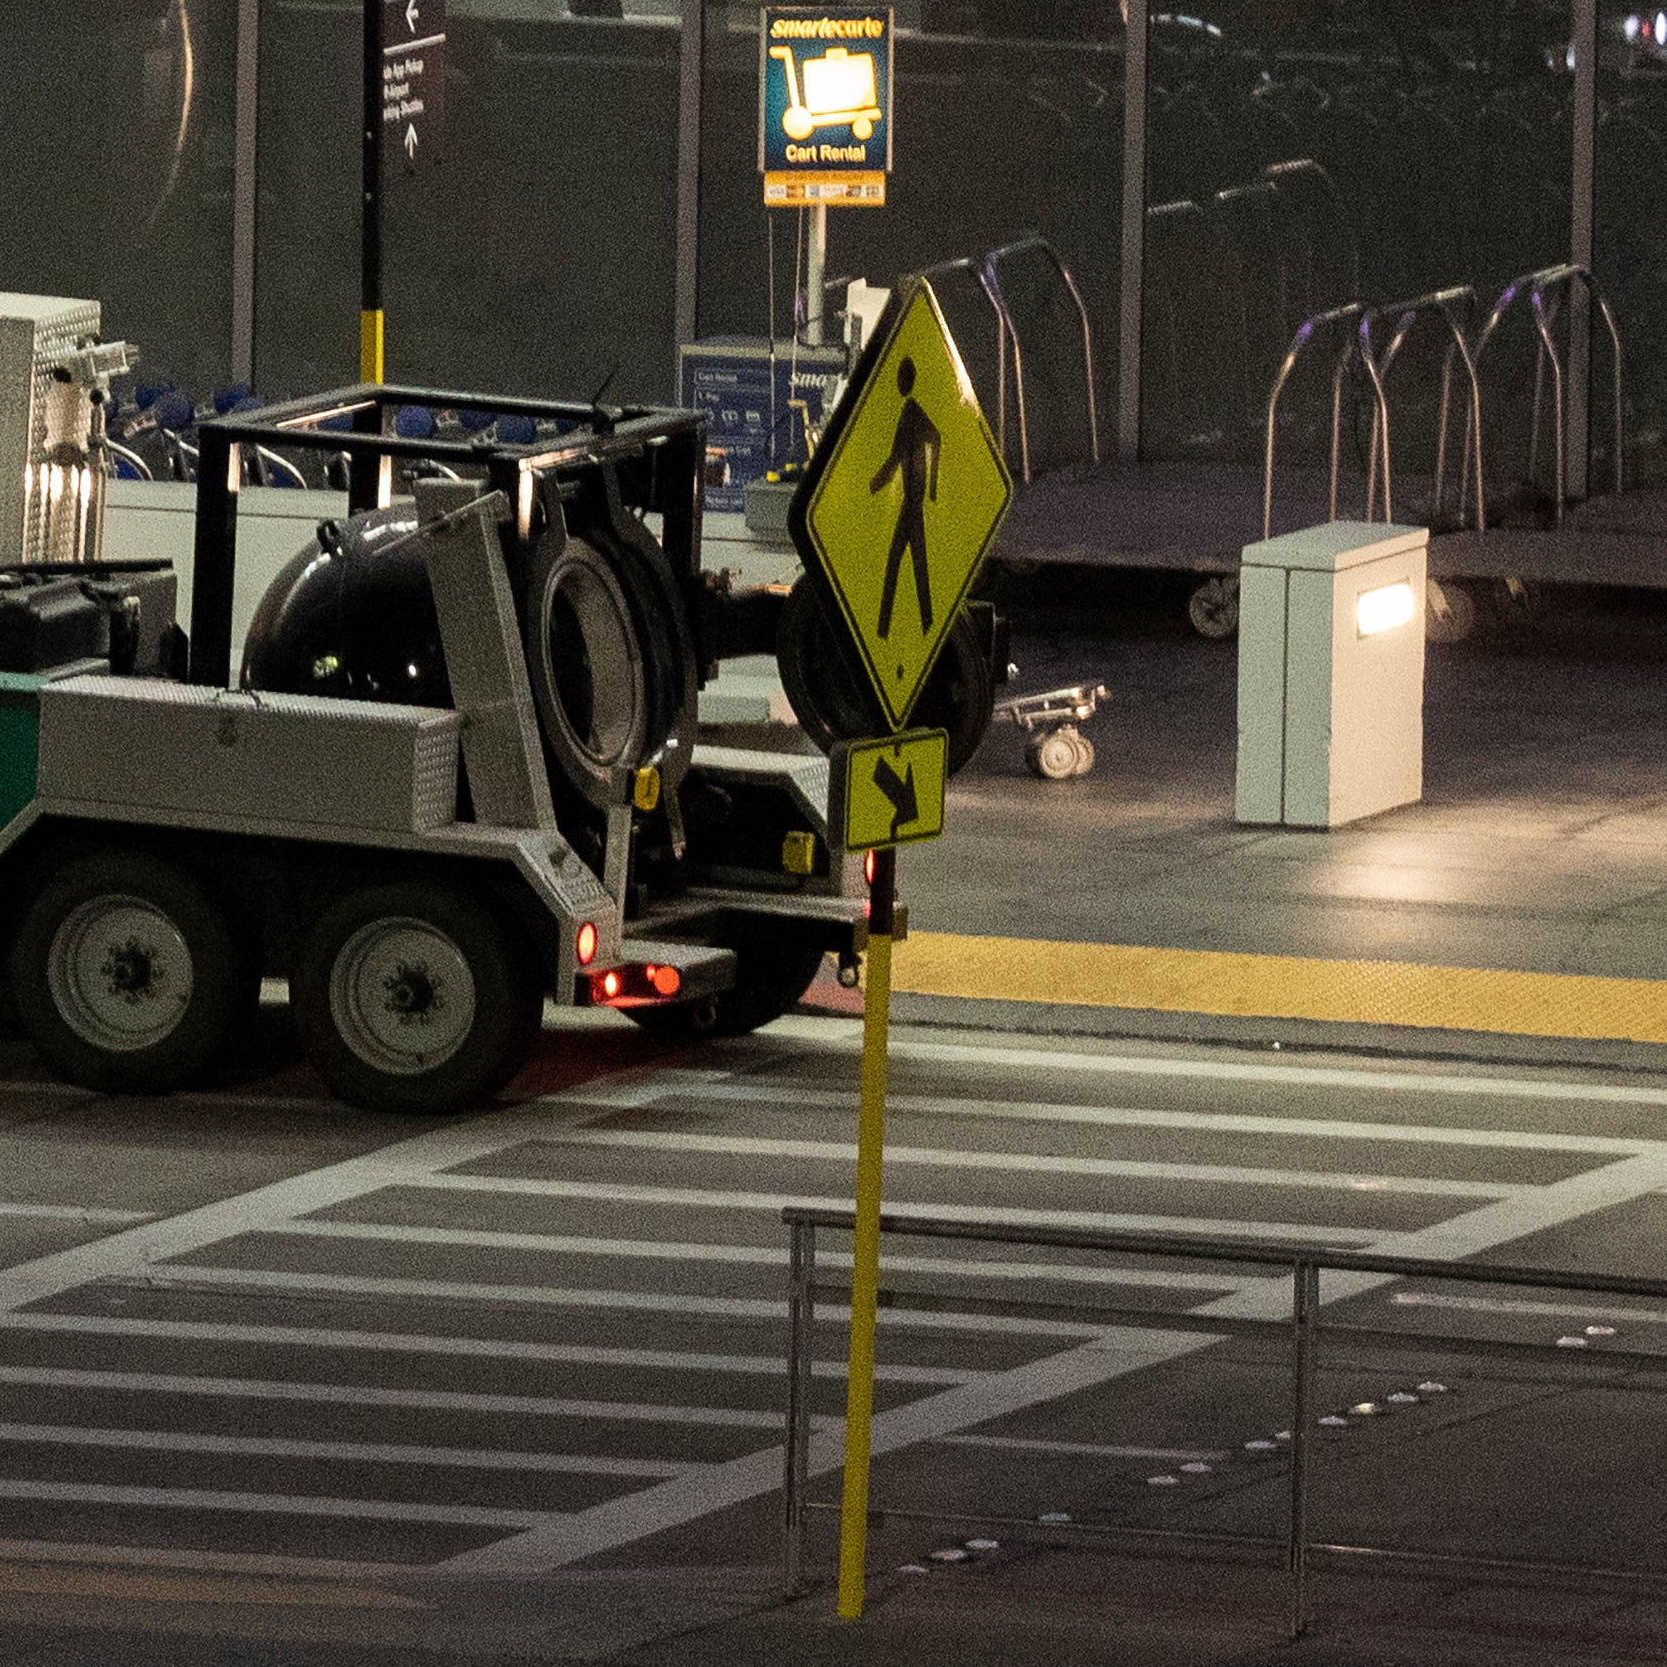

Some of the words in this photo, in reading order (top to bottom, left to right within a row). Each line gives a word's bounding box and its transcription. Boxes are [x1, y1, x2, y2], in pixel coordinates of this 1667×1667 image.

[770, 16, 884, 38] smartecarte
[785, 144, 818, 162] Cart
[819, 144, 866, 162] Rental
